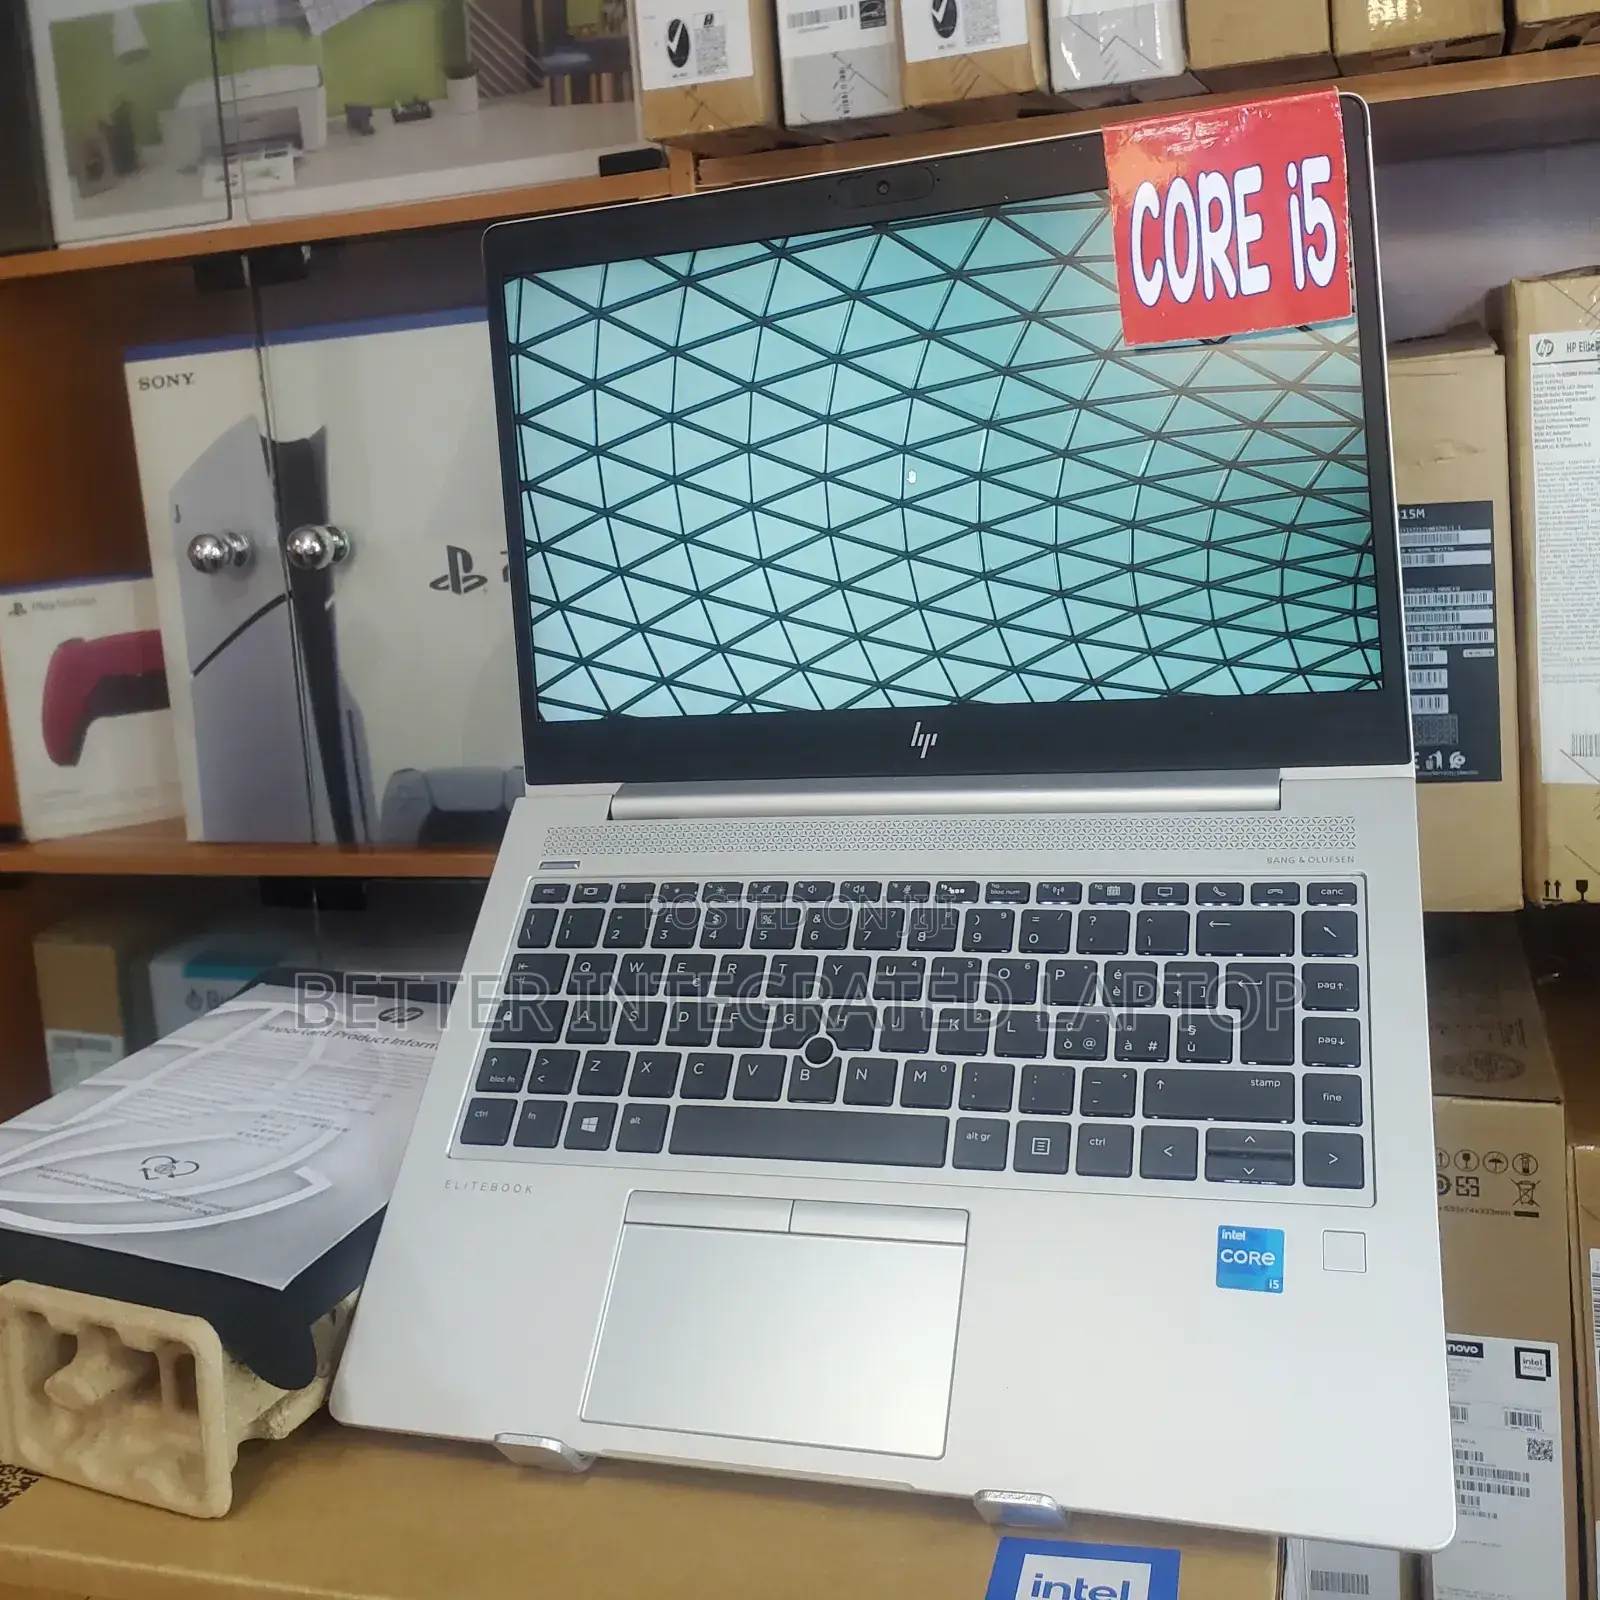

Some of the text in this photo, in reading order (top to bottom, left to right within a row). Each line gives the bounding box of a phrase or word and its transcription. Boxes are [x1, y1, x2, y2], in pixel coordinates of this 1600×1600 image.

[1130, 155, 1338, 307] CORE i5
[138, 371, 196, 391] SONY
[1398, 508, 1426, 520] 15M
[910, 721, 938, 758] hp
[1266, 855, 1355, 864] BANG & OLUFSEN
[542, 887, 556, 895] esc
[1321, 888, 1344, 896] canc
[812, 913, 822, 924] &
[611, 930, 620, 940] 2
[660, 930, 668, 940] 3
[708, 930, 717, 940] 4
[759, 930, 768, 941] 5
[810, 930, 819, 941] 6
[863, 931, 872, 941] 7
[917, 931, 927, 942] 8
[972, 932, 982, 943] 9
[579, 962, 592, 973] Q
[629, 962, 645, 973] W
[676, 962, 687, 973] E
[726, 963, 738, 974] R
[778, 964, 788, 974] T
[832, 964, 843, 975] Y
[885, 965, 896, 977] U
[998, 968, 1011, 980] O
[1055, 969, 1065, 980] P
[1317, 981, 1336, 991] pag
[578, 1010, 590, 1021] A
[628, 1010, 639, 1022] S
[678, 1011, 690, 1022] D
[729, 1012, 740, 1023] F
[783, 1013, 795, 1025] G
[836, 1014, 848, 1025] H
[891, 1016, 900, 1028] J
[949, 1018, 960, 1031] K
[1007, 1021, 1016, 1032] L
[260, 1024, 438, 1050] Important Product Inform
[1318, 1036, 1337, 1046] pag
[1082, 1037, 1096, 1050] @
[1148, 1040, 1158, 1051] #
[590, 1060, 601, 1072] Z
[640, 1061, 652, 1073] X
[693, 1063, 705, 1075] C
[747, 1064, 758, 1076] V
[489, 1075, 516, 1084] bloc fn
[800, 1069, 811, 1081] B
[856, 1068, 868, 1081] N
[913, 1070, 927, 1083] M
[1250, 1077, 1281, 1089] stamp
[1322, 1092, 1342, 1102] fine
[474, 1109, 489, 1118] ctrl
[527, 1111, 537, 1121] fn
[629, 1116, 642, 1125] alt
[966, 1131, 991, 1143] alt gr
[1089, 1136, 1106, 1146] ctrl
[444, 1179, 534, 1195] ELITEBOOK
[1222, 1229, 1246, 1241] intel
[1269, 1278, 1280, 1290] i5
[1446, 1343, 1479, 1354] novo
[1031, 1572, 1131, 1600] intel
